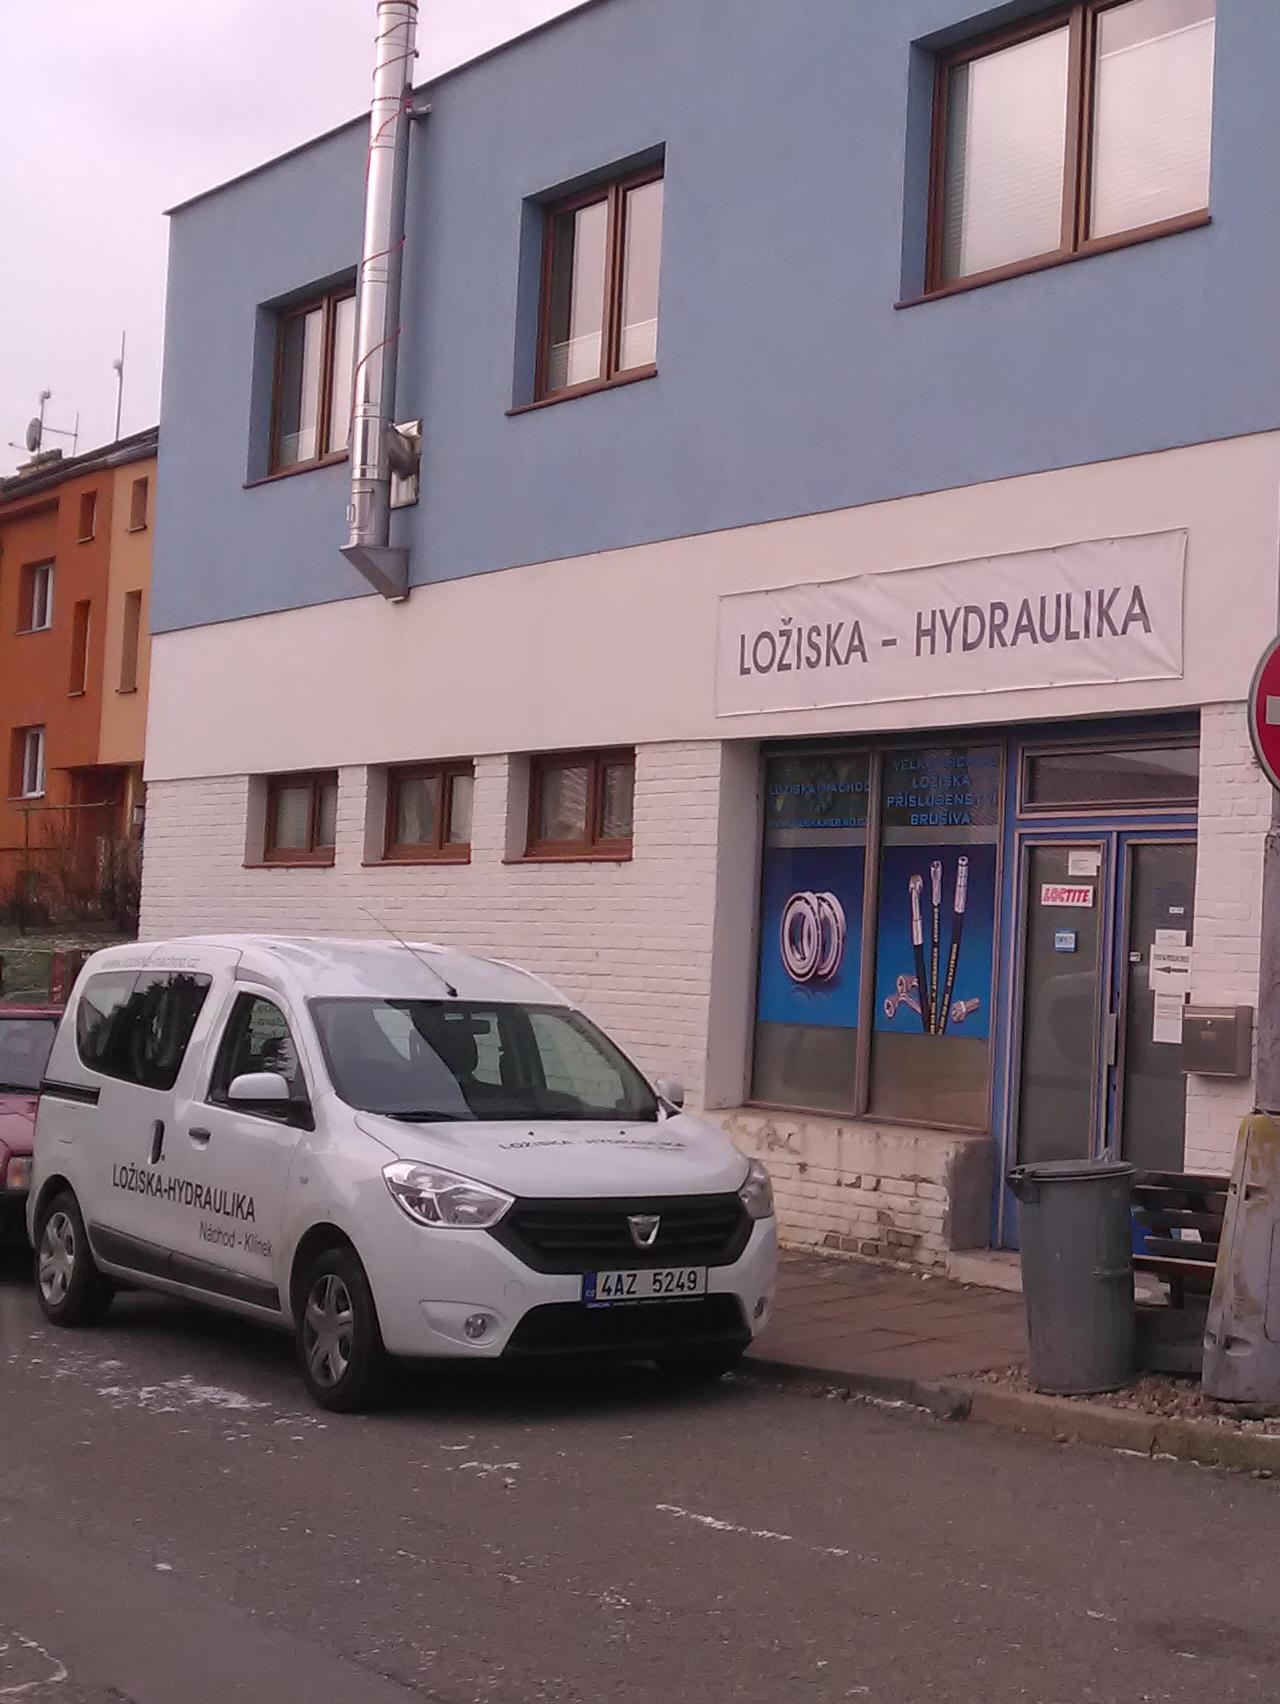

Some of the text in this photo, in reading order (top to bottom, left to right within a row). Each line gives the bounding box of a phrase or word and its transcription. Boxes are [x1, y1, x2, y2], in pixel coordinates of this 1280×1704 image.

[739, 617, 868, 676] LOŽISKA
[914, 584, 1152, 657] HYDRAULIKA
[112, 1163, 256, 1223] LOŽISKA-HYDRAULIKA
[602, 1270, 698, 1296] 4AZ 5249
